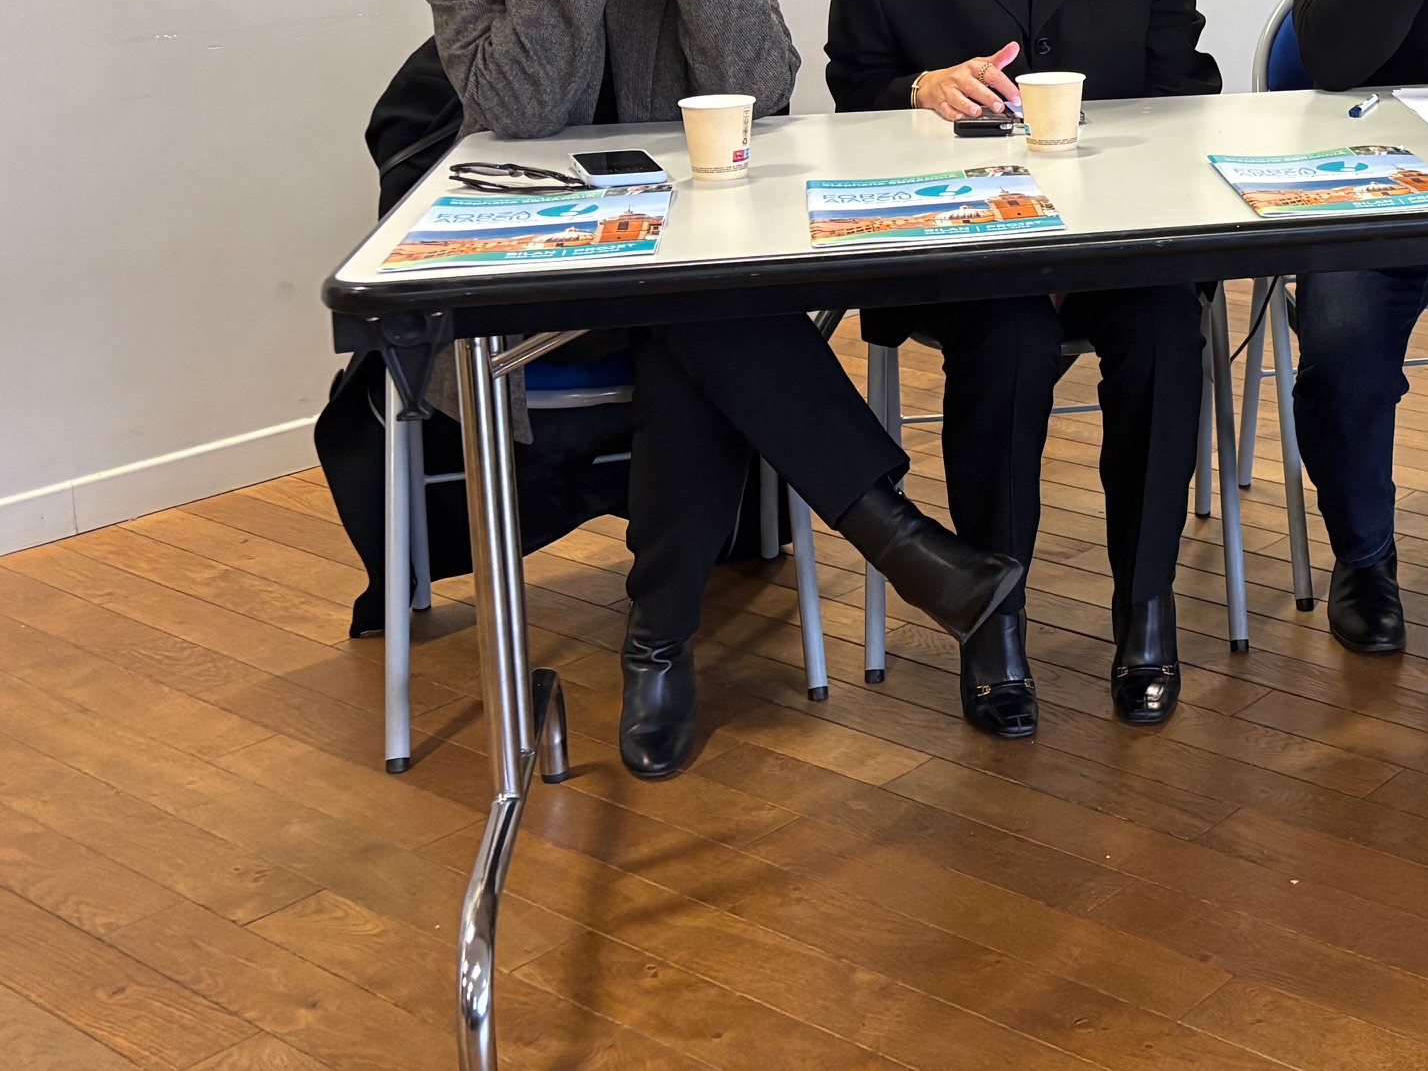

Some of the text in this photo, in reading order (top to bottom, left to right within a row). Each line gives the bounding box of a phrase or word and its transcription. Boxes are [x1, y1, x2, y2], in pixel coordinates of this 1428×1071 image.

[823, 191, 912, 200] FORZA
[1352, 198, 1395, 206] BILAN
[437, 211, 531, 219] FORZA
[986, 220, 1043, 229] PROJET
[573, 243, 636, 252] PROJET
